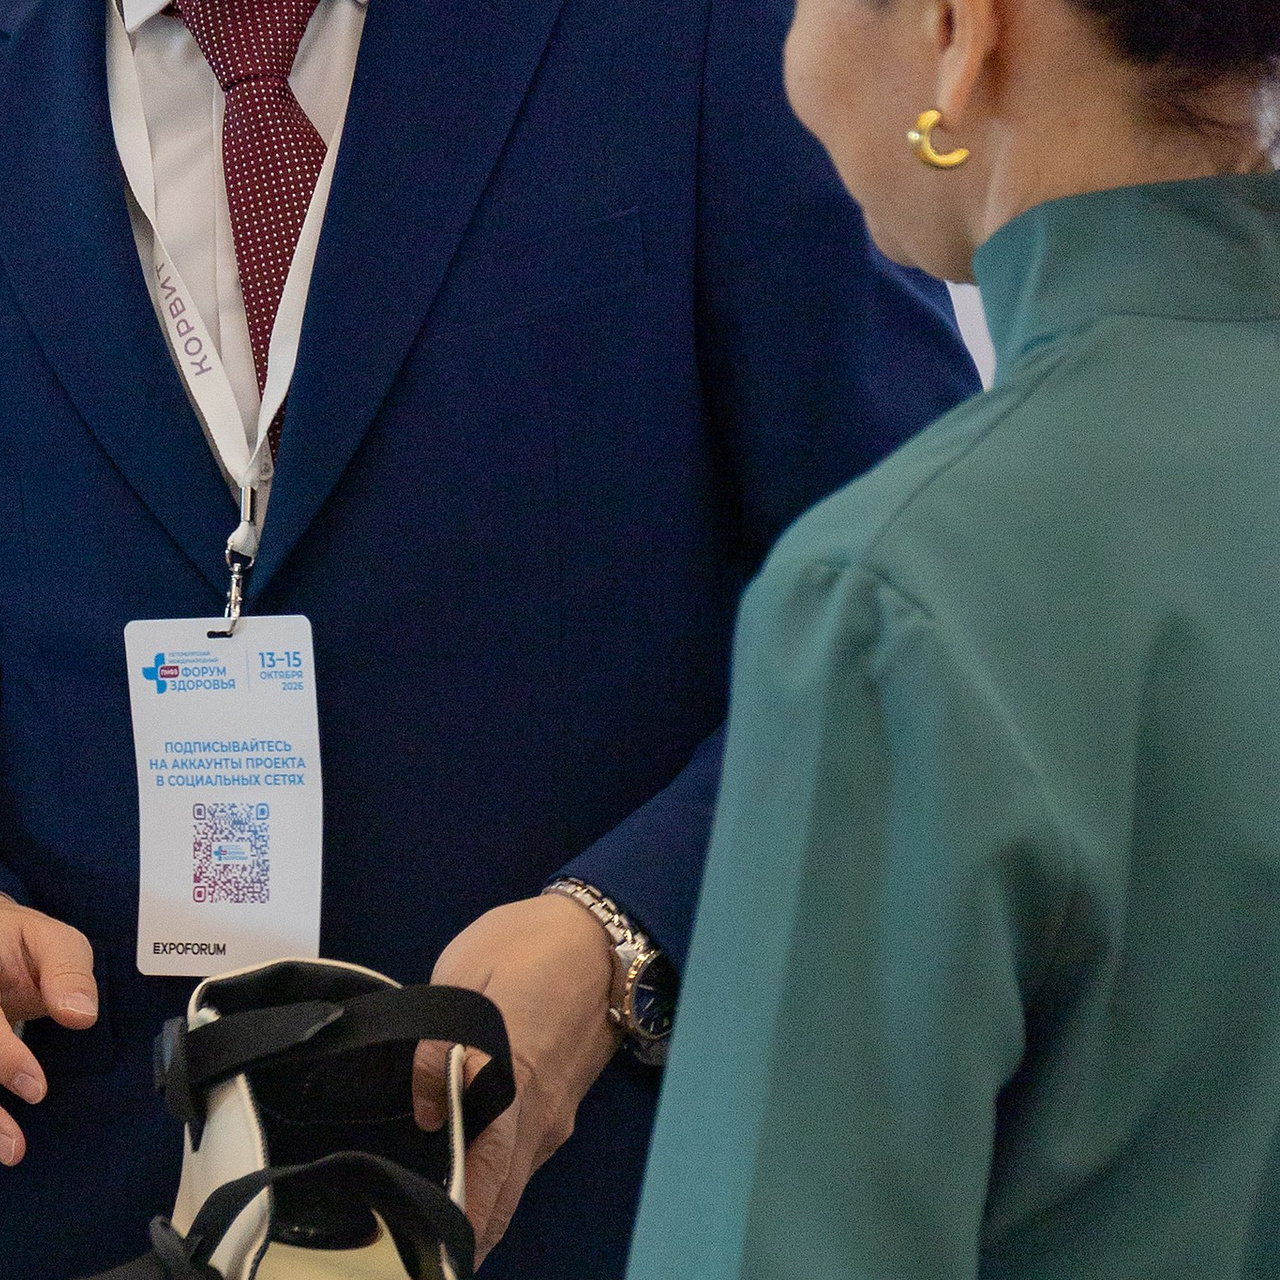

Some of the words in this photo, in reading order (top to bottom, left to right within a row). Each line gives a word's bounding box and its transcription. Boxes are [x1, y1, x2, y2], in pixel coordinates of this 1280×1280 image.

[155, 263, 212, 376] КОРВИТ
[181, 666, 227, 677] ФОРУМ
[260, 670, 303, 680] ОКТЯБРЯ
[170, 679, 236, 691] ЗДОРОВЬЯ
[164, 738, 292, 755] ПОДПИСЫВАЙТЕСЬ
[149, 758, 168, 770] НА
[171, 758, 243, 770] АККАУНТЫ
[246, 757, 306, 769] ПРОЕКТА
[156, 776, 165, 787] В
[168, 775, 261, 788] СОЦИАЛЬНЫХ
[264, 774, 305, 786] СЕТЯХ
[153, 942, 226, 956] EXPOFORUM
